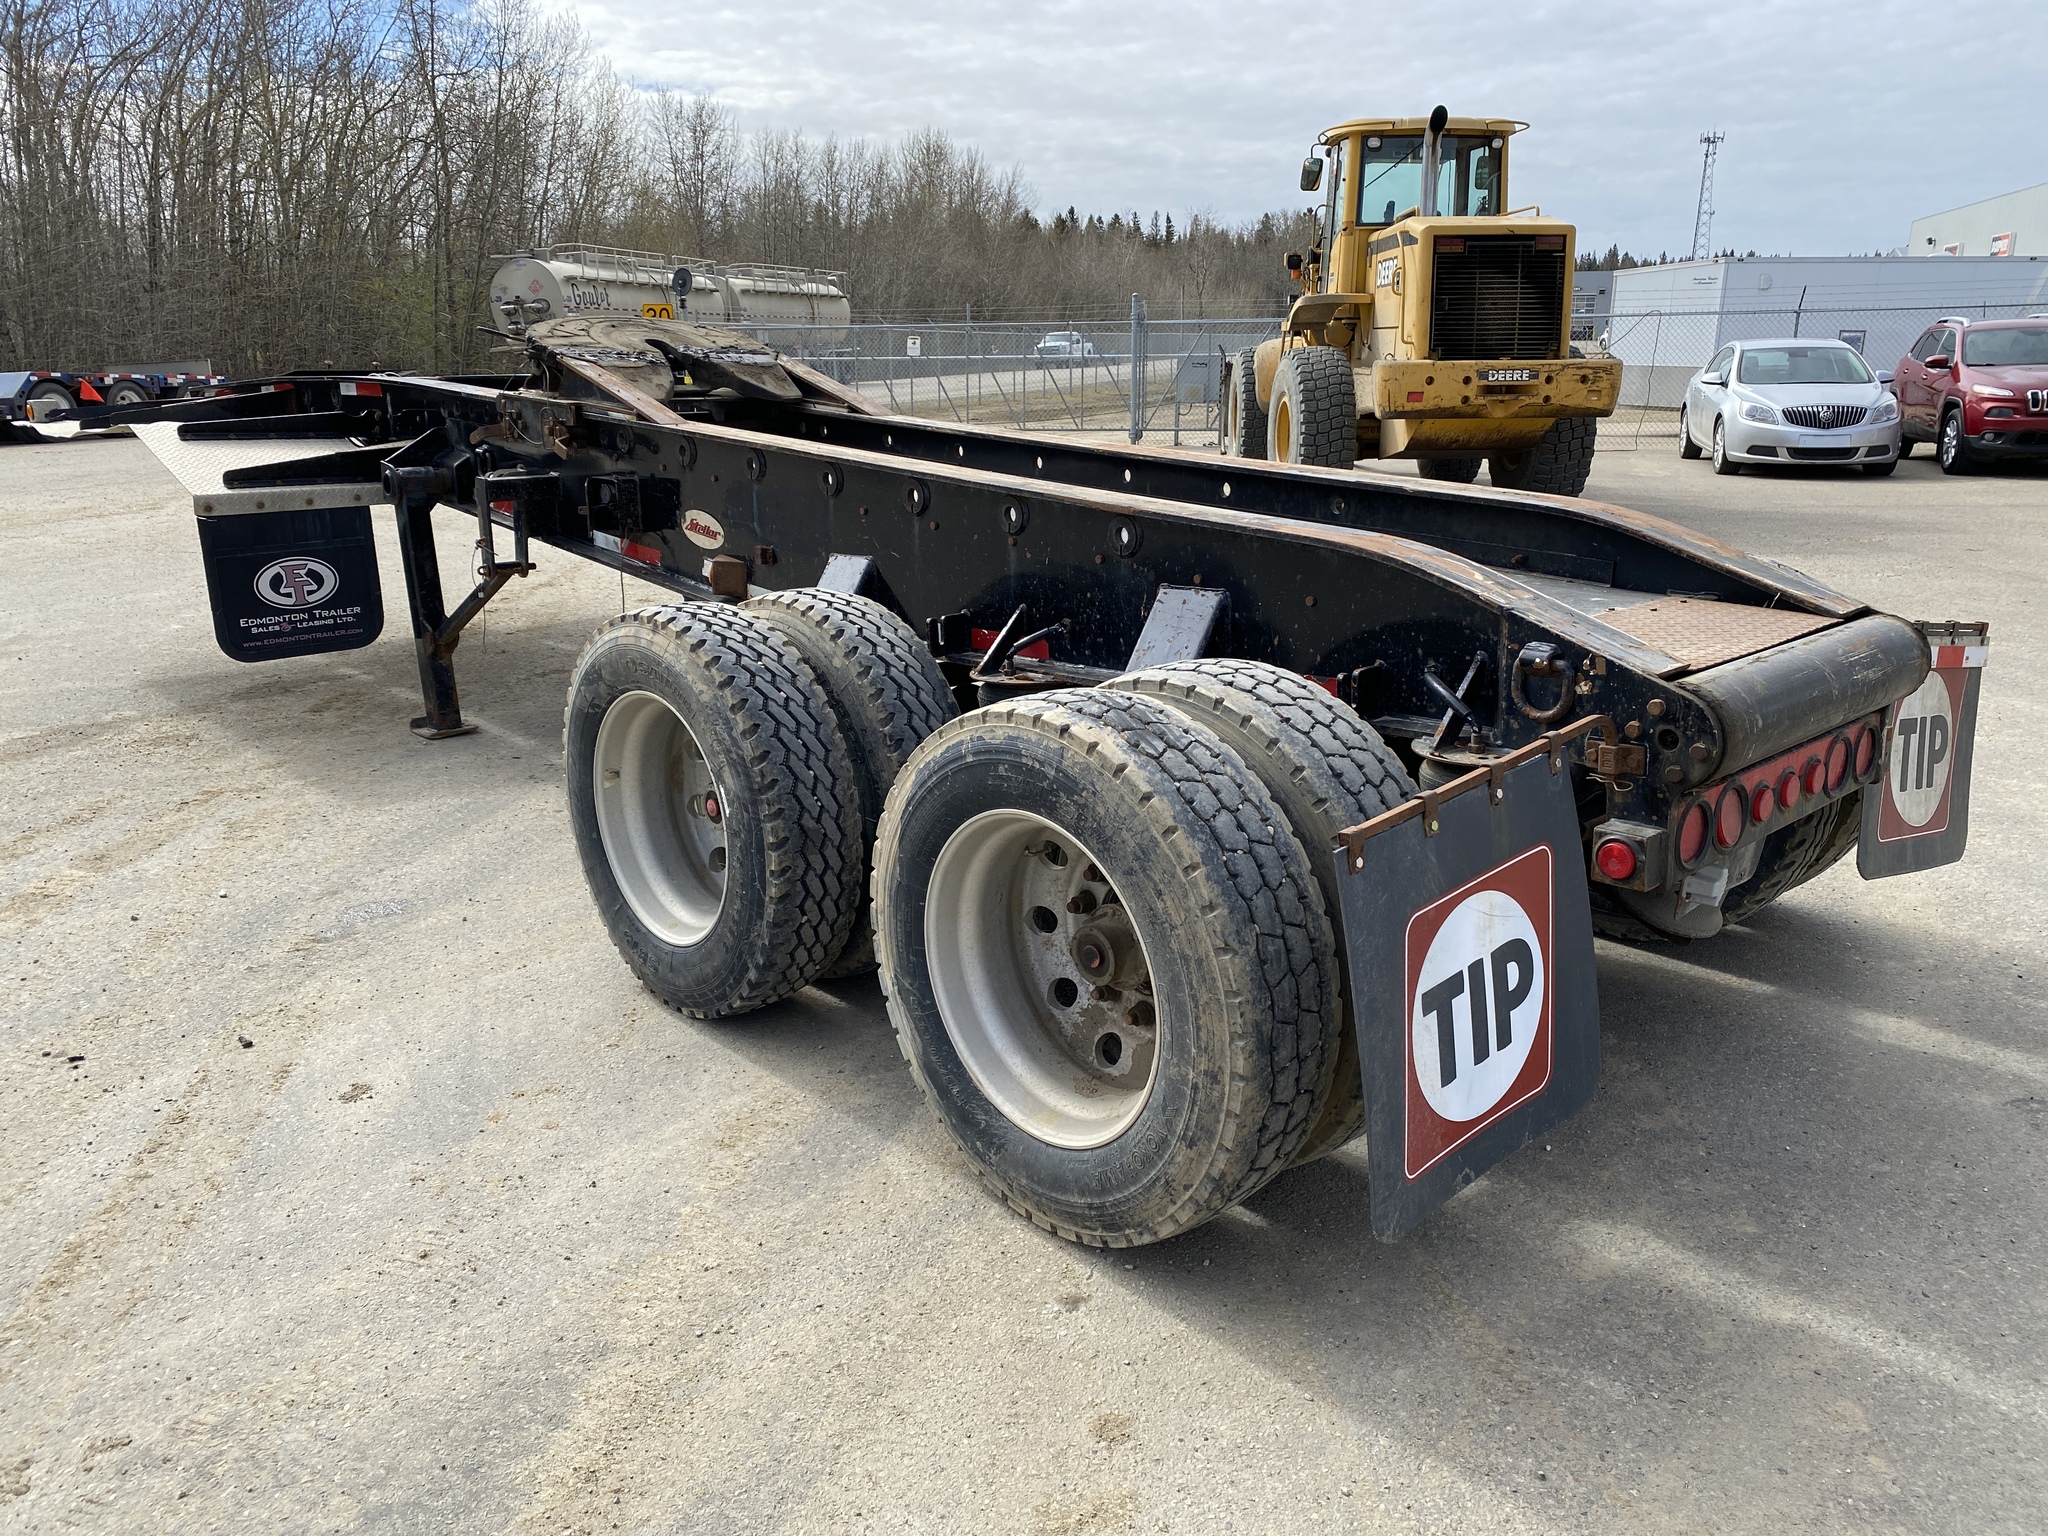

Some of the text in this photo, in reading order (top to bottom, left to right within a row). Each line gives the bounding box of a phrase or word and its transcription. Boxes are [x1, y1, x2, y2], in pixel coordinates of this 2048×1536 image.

[1488, 369, 1530, 382] DEERE
[239, 606, 361, 627] EDMONTON TRAILER
[251, 625, 280, 634] SALES
[296, 618, 334, 628] LEASING
[1897, 714, 1949, 793] TIP
[1421, 937, 1534, 1089] TIP
[1091, 1119, 1168, 1190] YOKOHAMA
